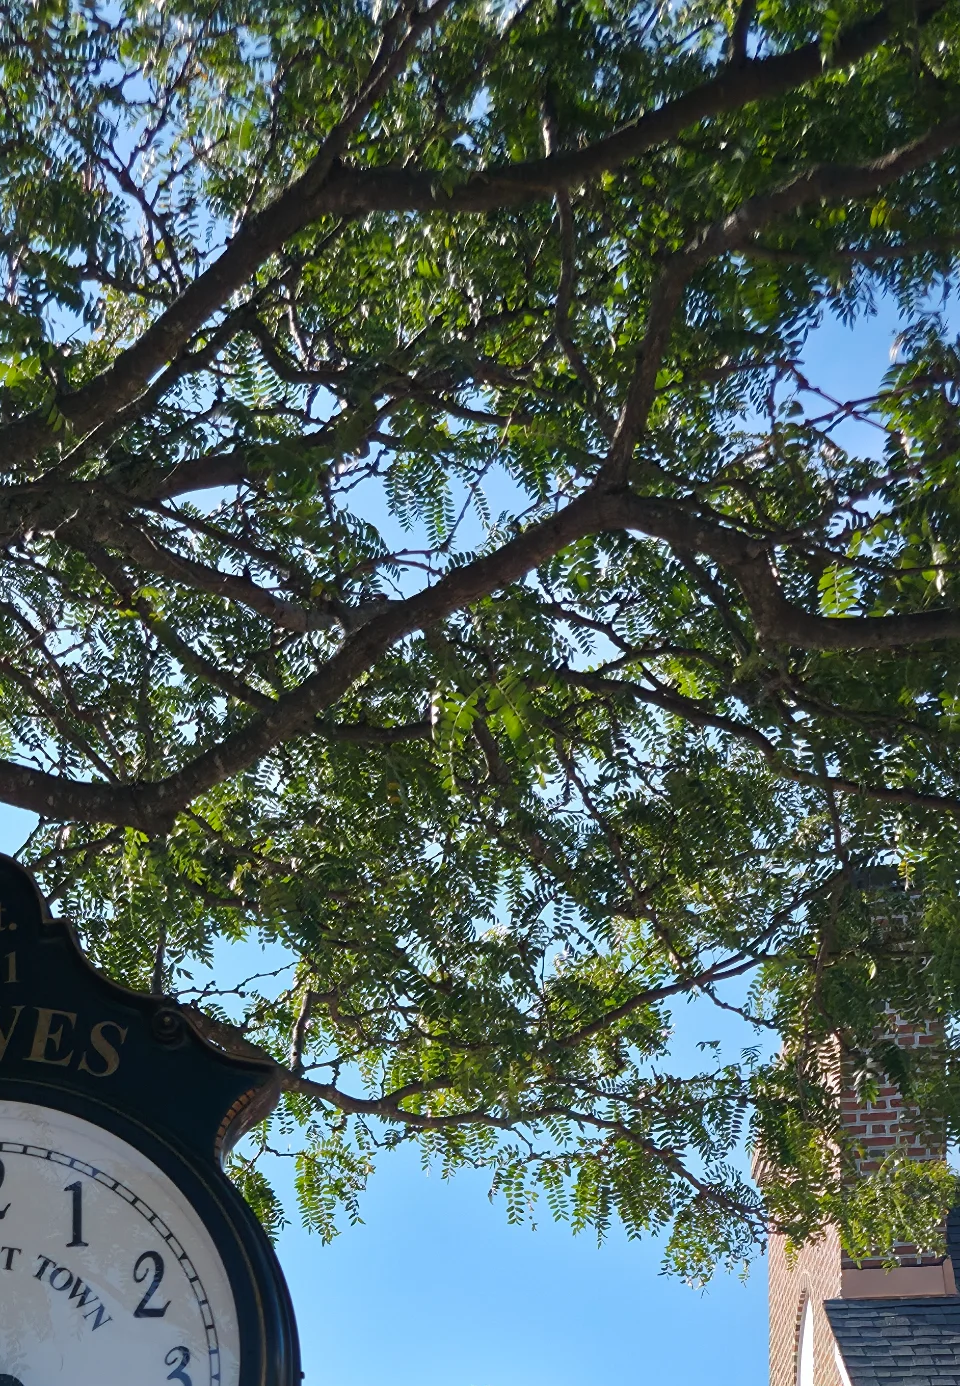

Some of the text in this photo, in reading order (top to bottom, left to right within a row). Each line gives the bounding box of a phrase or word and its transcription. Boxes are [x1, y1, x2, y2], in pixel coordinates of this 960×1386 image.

[63, 1180, 89, 1248] 1
[32, 1254, 113, 1332] TOWN
[132, 1250, 172, 1319] 2
